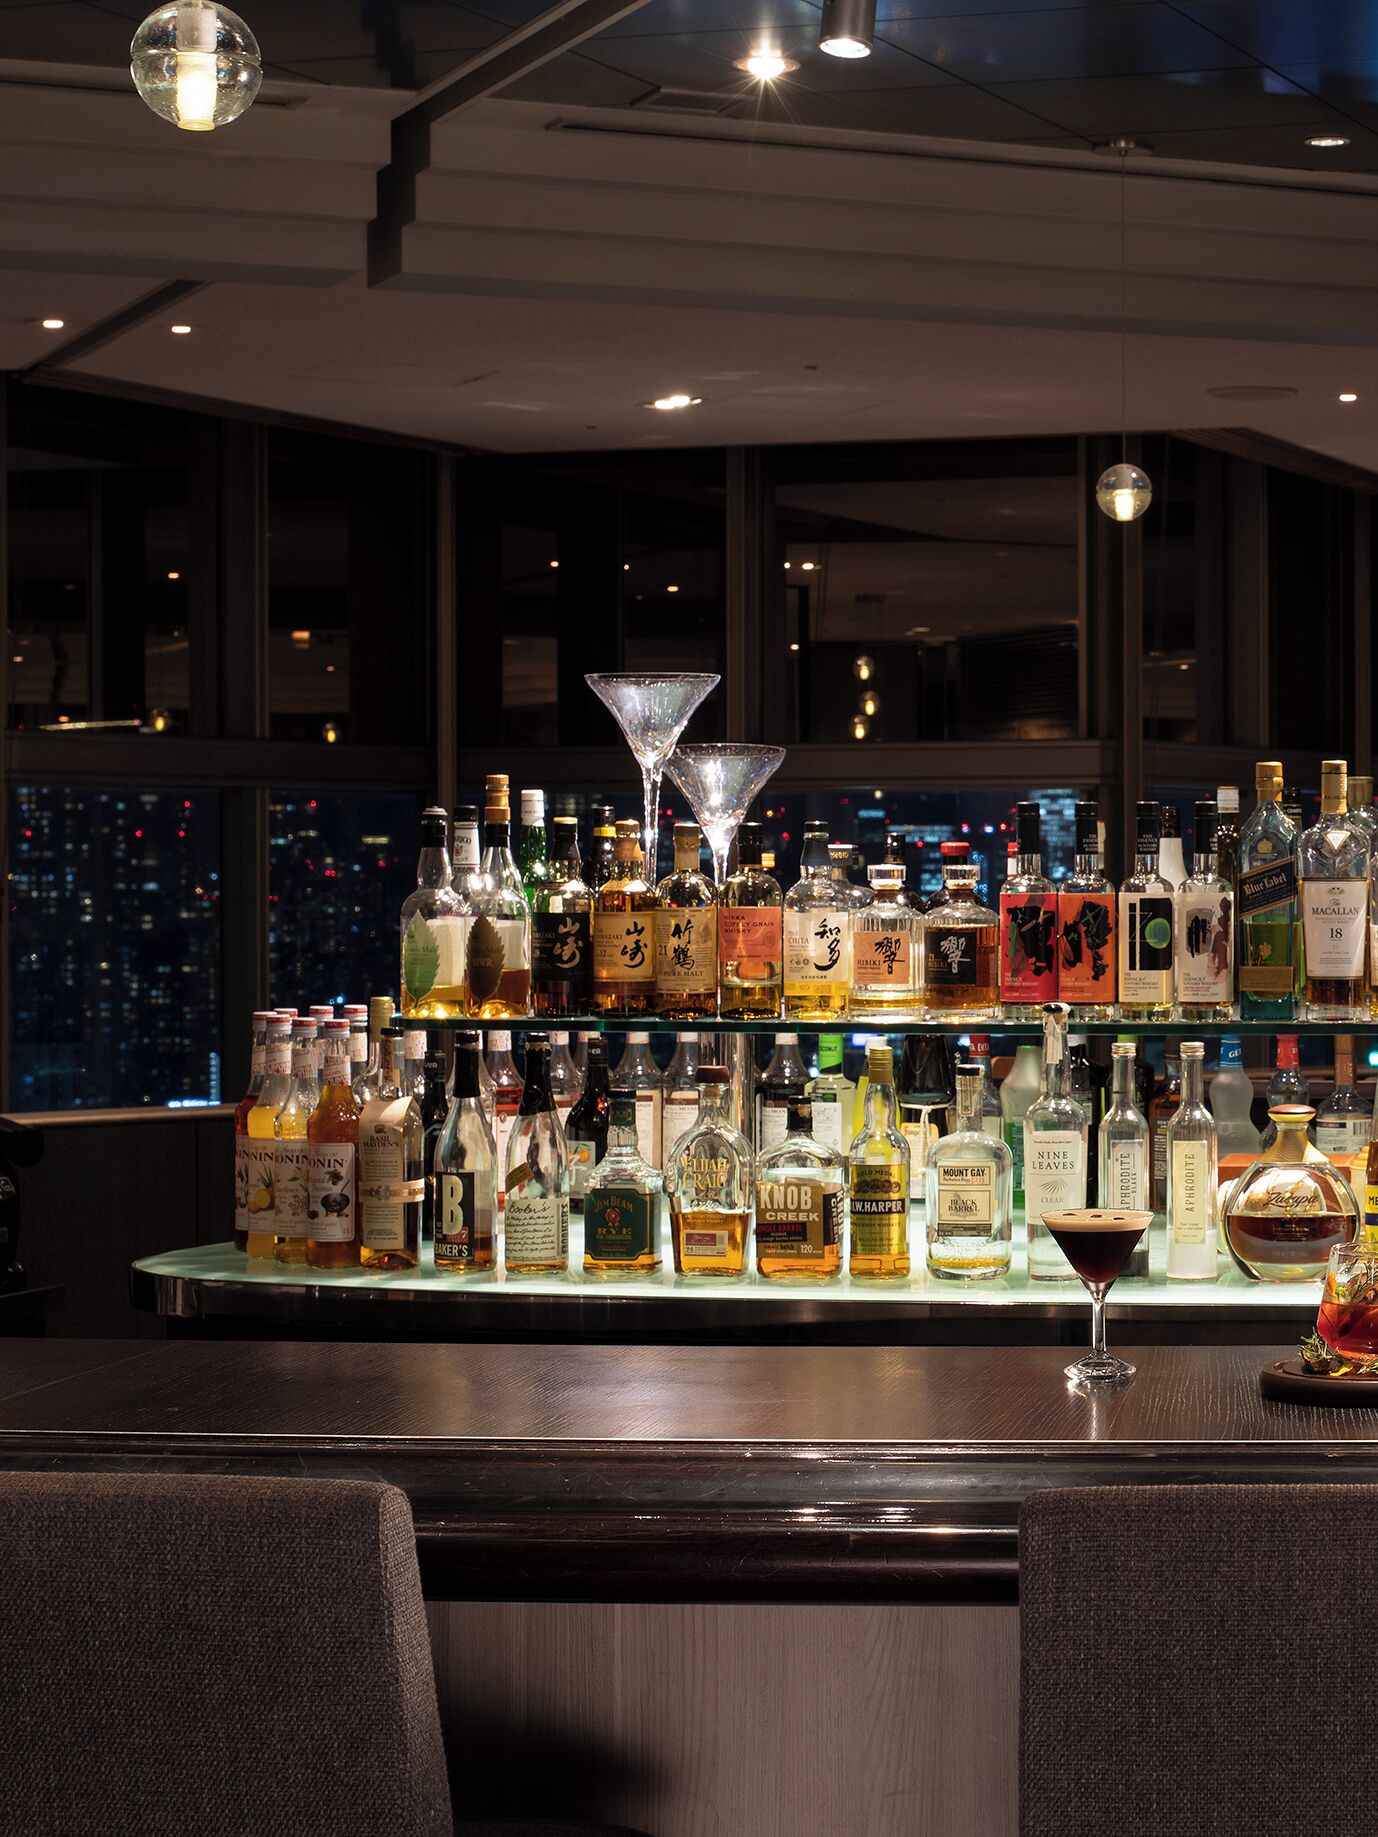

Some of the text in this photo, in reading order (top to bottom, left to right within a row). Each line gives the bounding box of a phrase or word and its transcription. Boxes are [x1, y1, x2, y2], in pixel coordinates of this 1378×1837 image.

[1243, 883, 1265, 896] Blue
[1263, 872, 1287, 889] Label
[1311, 907, 1360, 915] MACALLAN
[1330, 928, 1343, 938] 18
[620, 920, 648, 969] 山崎
[658, 944, 668, 956] 21
[671, 919, 695, 970] 竹鶴
[813, 917, 841, 971] 知多
[1037, 1151, 1069, 1160] NINE
[683, 1157, 728, 1172] ELIJAH
[1032, 1161, 1075, 1170] LEAVES
[943, 1168, 986, 1177] MOUNT GAY
[682, 1171, 728, 1190] CRAIG
[1184, 1153, 1195, 1213] APHRODITE
[442, 1174, 464, 1235] B
[760, 1185, 812, 1210] KNOB
[765, 1211, 820, 1221] CREEK
[435, 1244, 469, 1257] BAKER'S
[800, 1244, 813, 1254] 120
